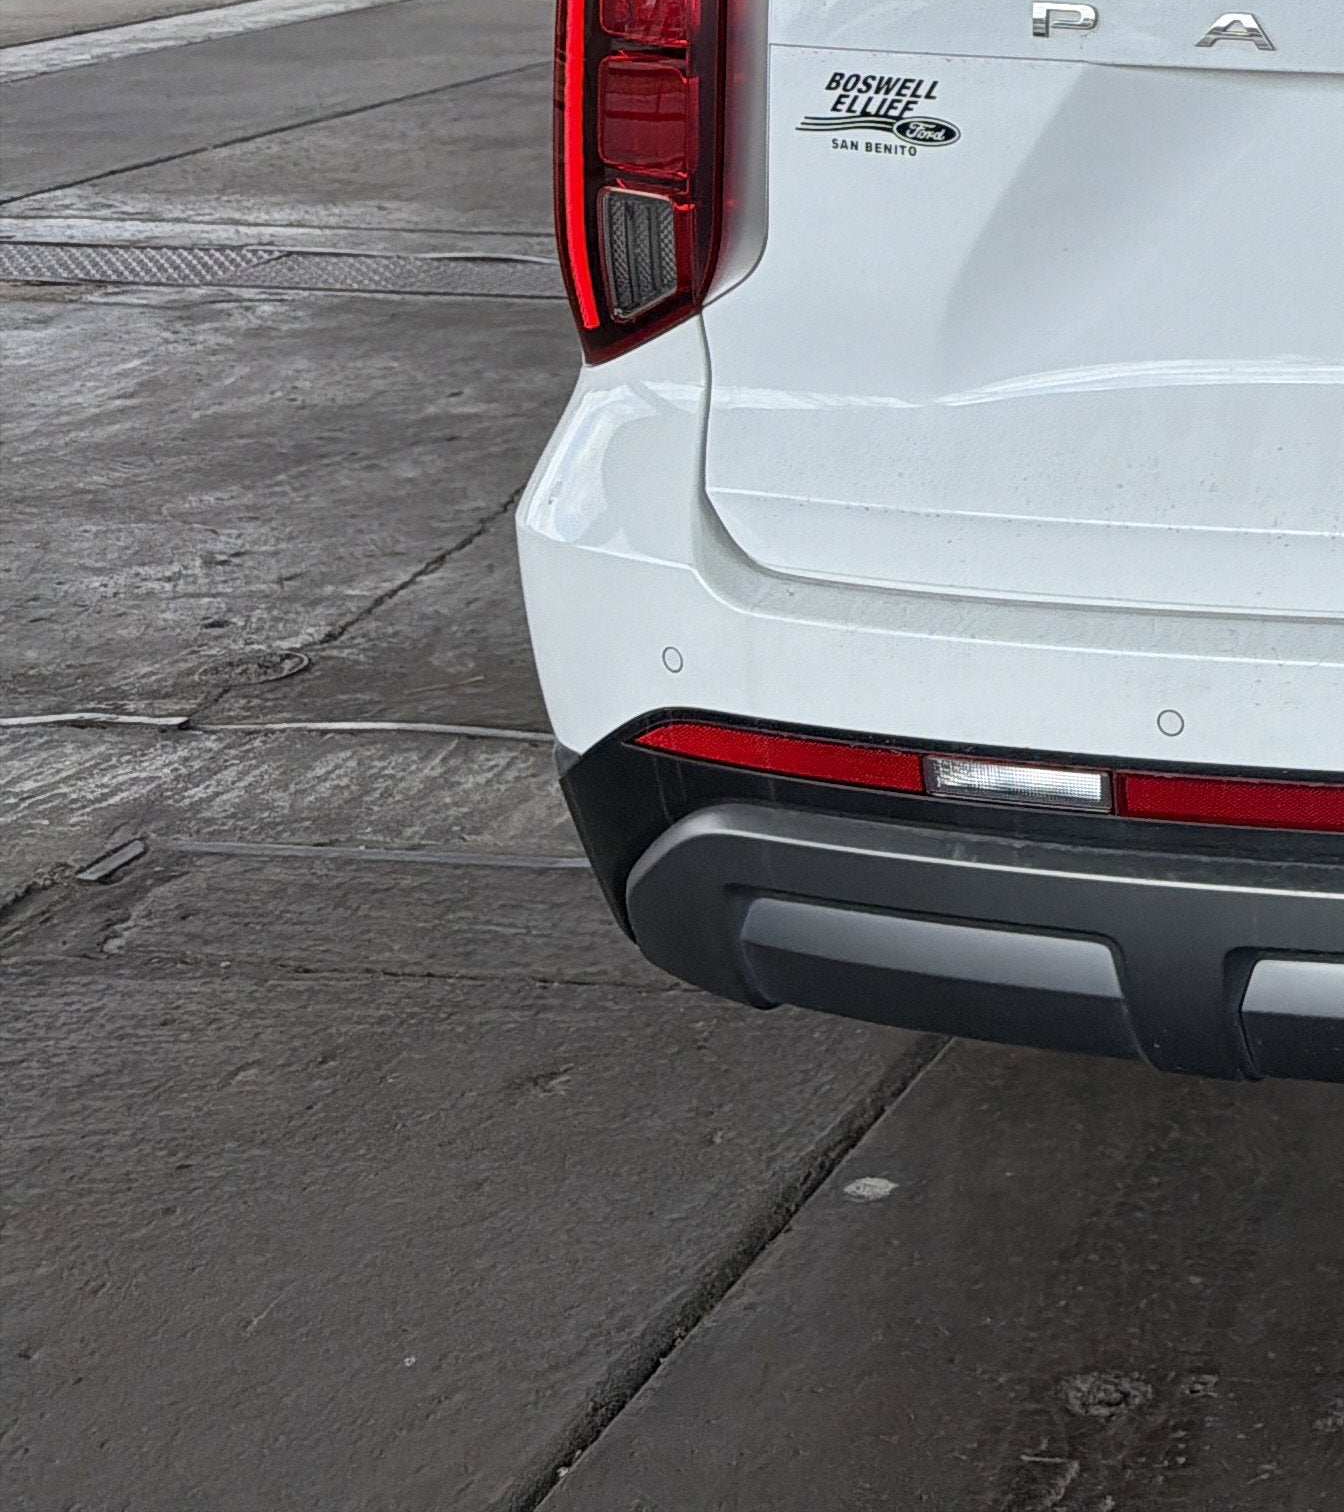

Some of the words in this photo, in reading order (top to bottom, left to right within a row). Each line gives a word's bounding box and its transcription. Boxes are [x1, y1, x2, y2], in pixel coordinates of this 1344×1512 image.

[825, 72, 939, 100] BOSWELL
[830, 94, 919, 118] ELLIFF
[905, 122, 946, 141] Ford
[832, 139, 859, 151] SAN
[865, 141, 917, 157] BENITO
